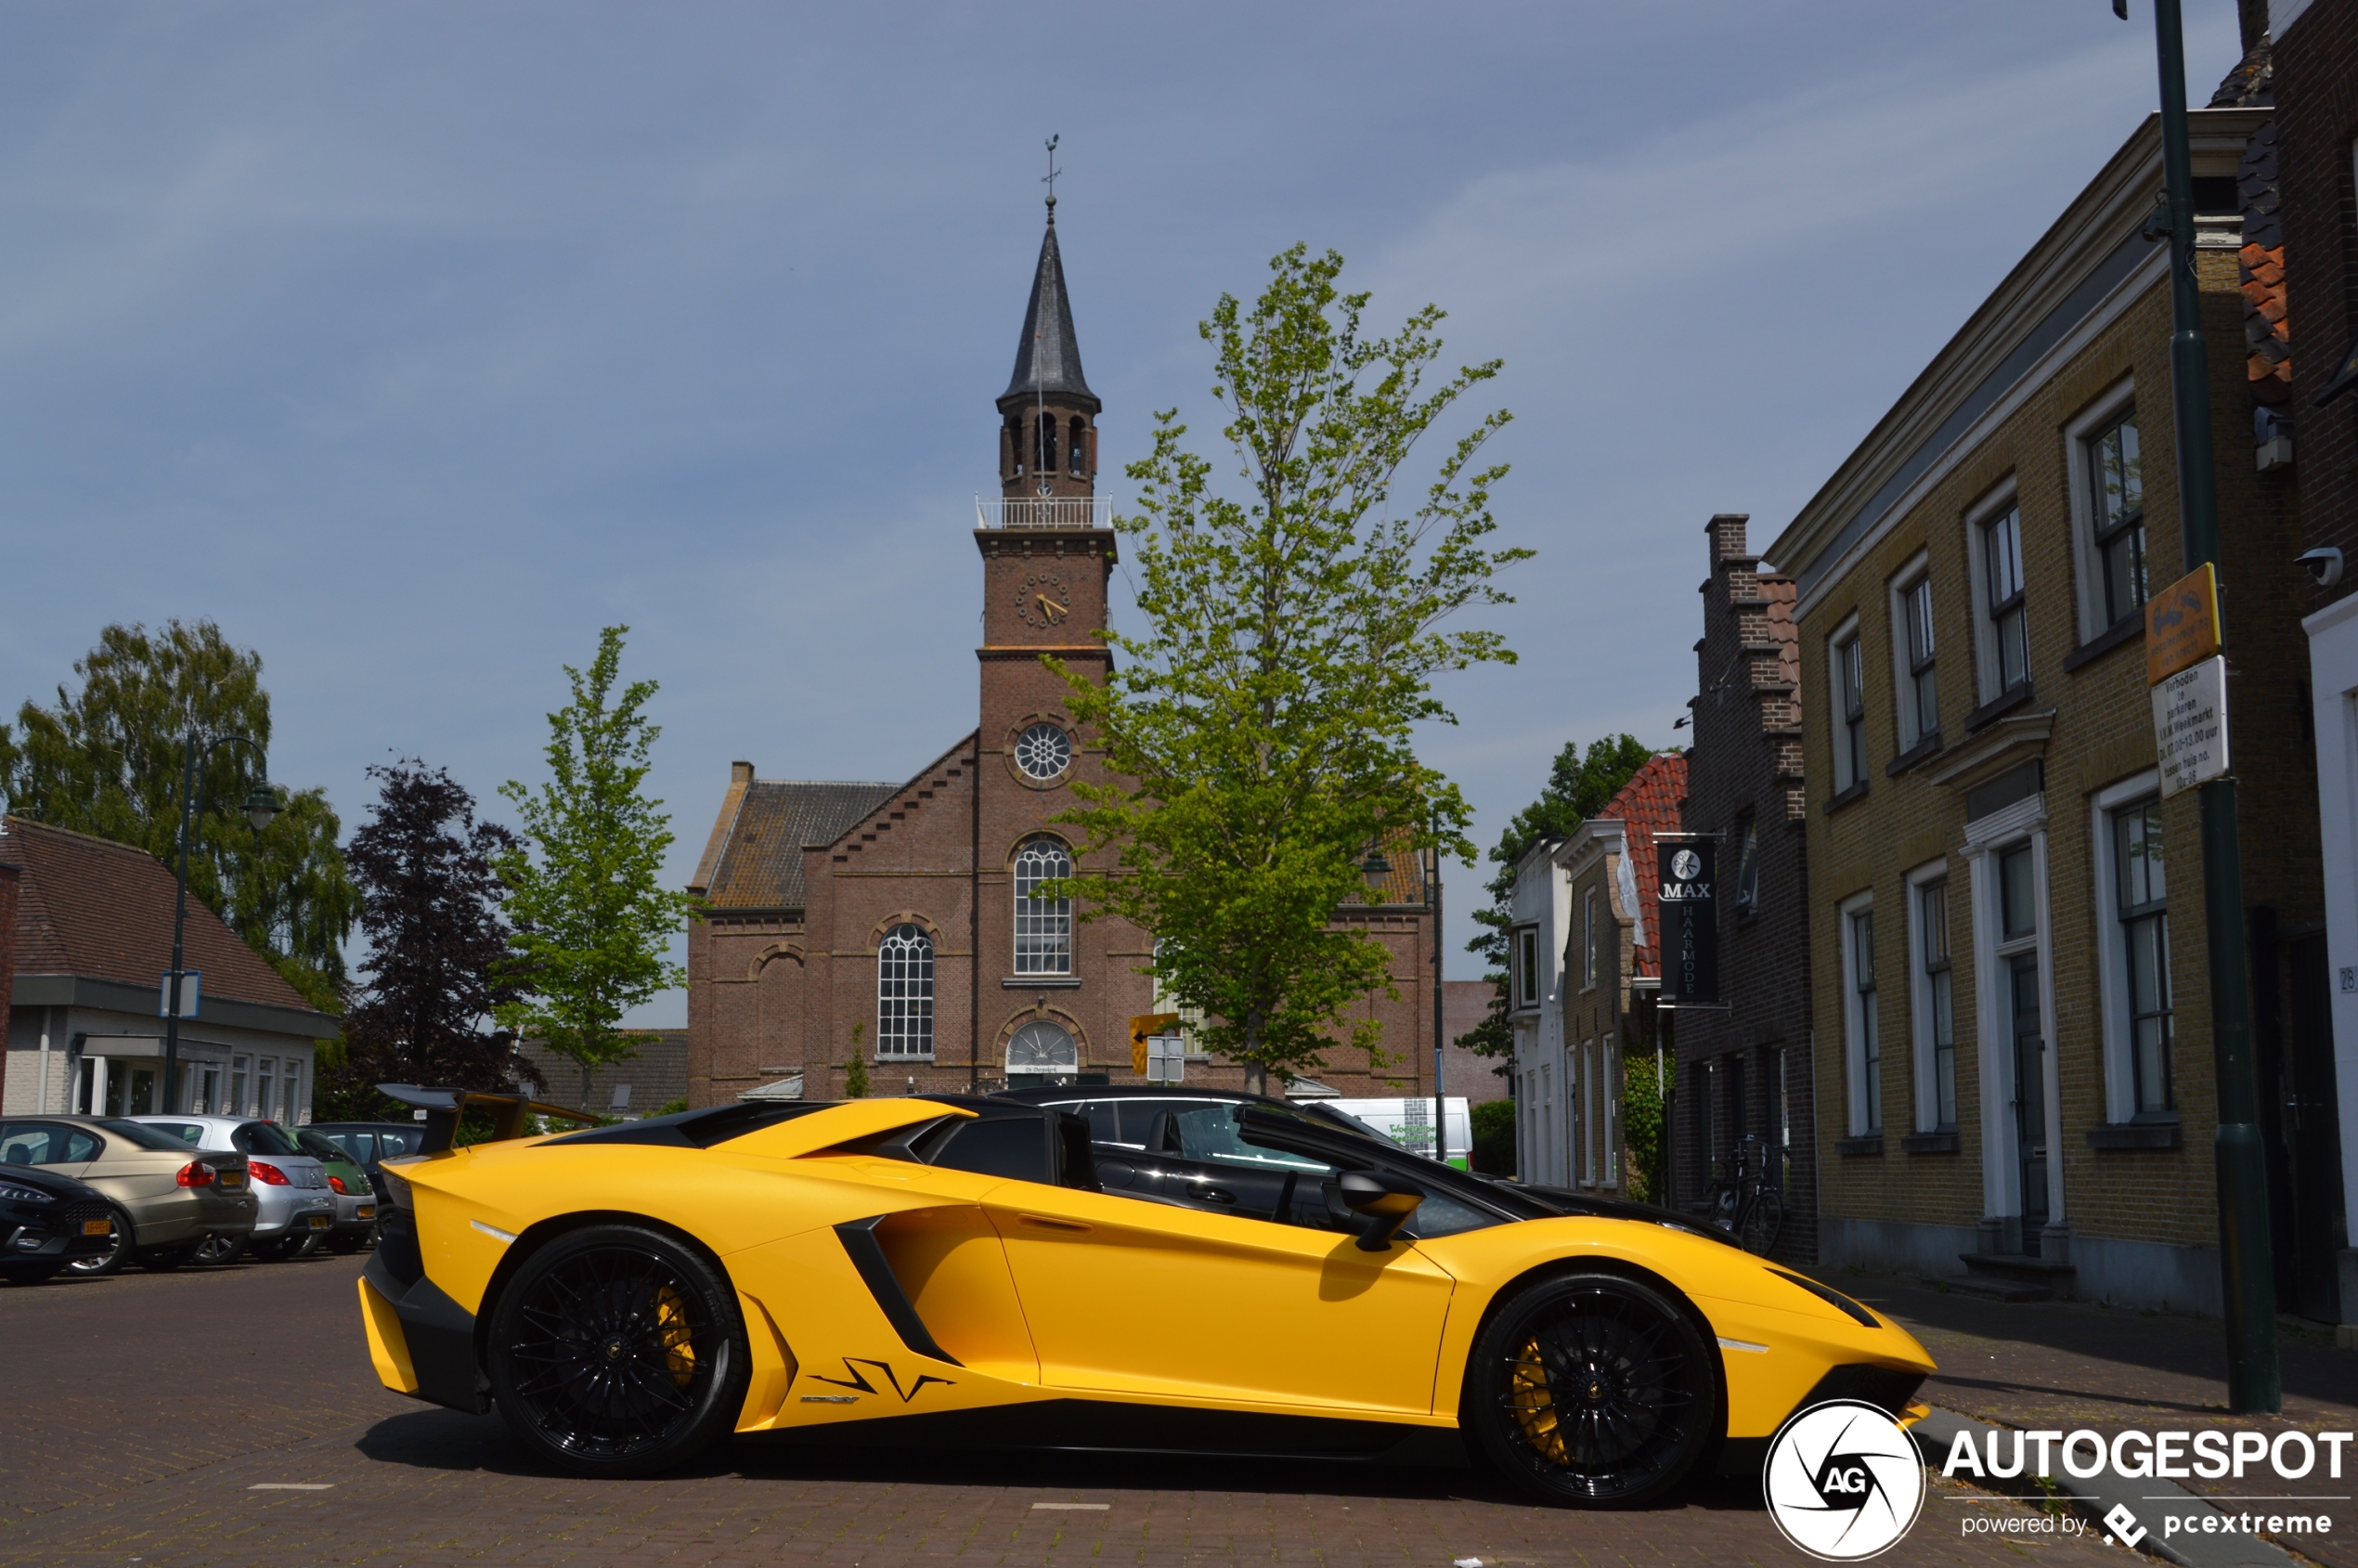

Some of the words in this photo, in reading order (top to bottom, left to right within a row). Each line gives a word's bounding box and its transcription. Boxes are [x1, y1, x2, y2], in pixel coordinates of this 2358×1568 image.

[2165, 670, 2198, 693] Verboden
[2177, 691, 2184, 701] te
[2167, 699, 2196, 722] parkeren
[2168, 729, 2204, 757] 07.00-13.00
[2206, 726, 2218, 739] uur
[2164, 762, 2183, 778] tussen
[2183, 754, 2197, 769] huis
[2198, 750, 2209, 762] no.
[1664, 883, 1711, 898] MAX
[1682, 906, 1696, 993] HAARMODE
[2341, 970, 2354, 990] 28
[1390, 1124, 1436, 1133] Woestenbe
